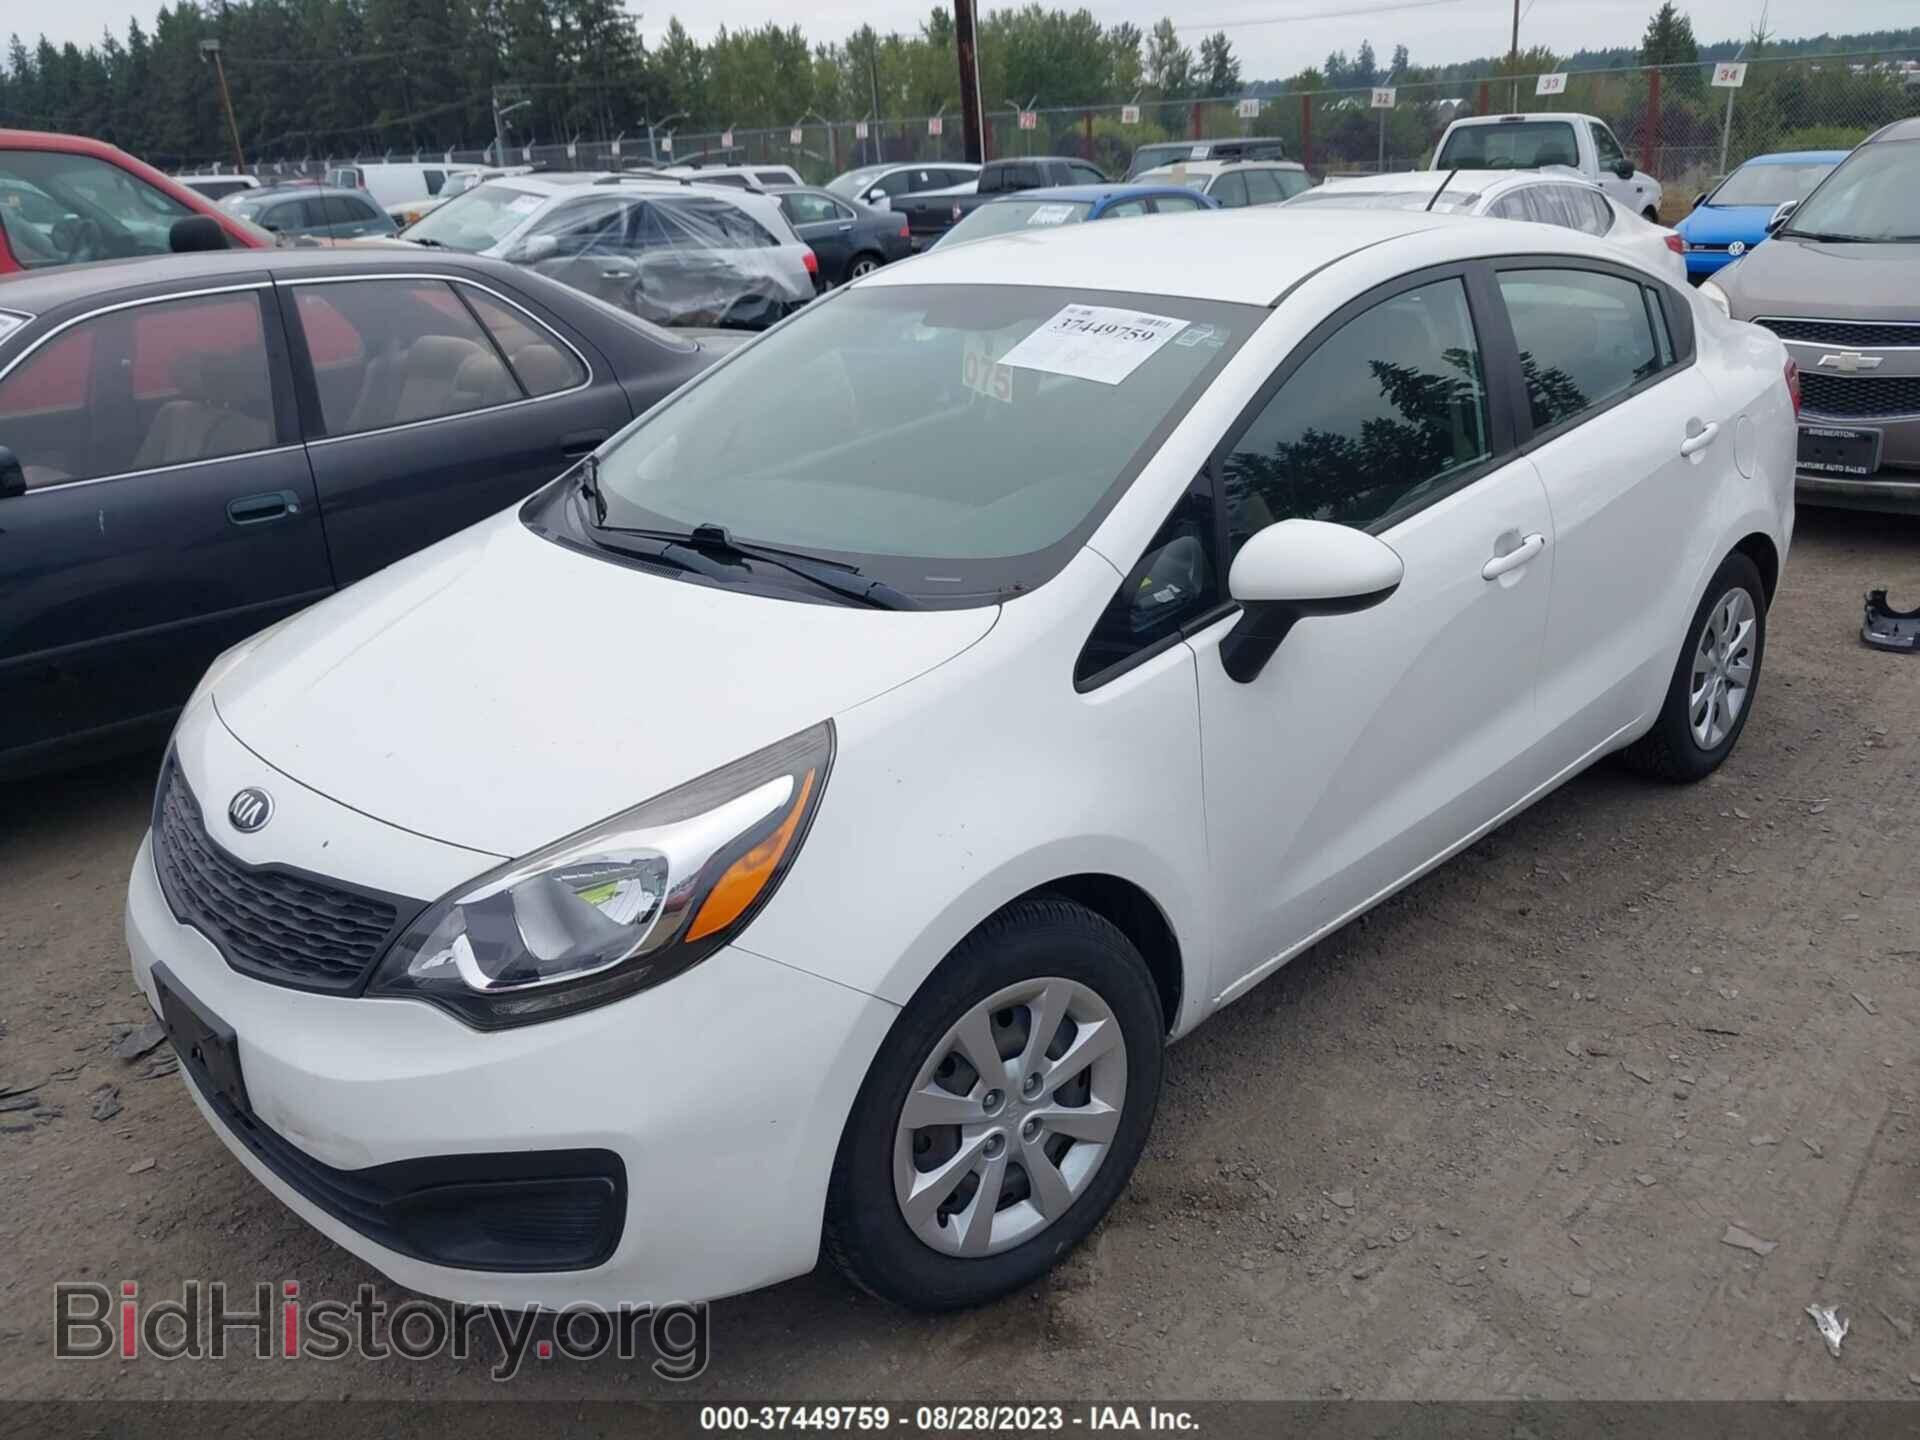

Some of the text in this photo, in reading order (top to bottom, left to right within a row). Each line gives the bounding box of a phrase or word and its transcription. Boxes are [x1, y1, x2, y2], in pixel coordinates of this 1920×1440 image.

[1720, 70, 1737, 81] 34
[1543, 79, 1560, 90] 33
[1052, 318, 1155, 343] 37449759
[1826, 464, 1844, 472] AUTO
